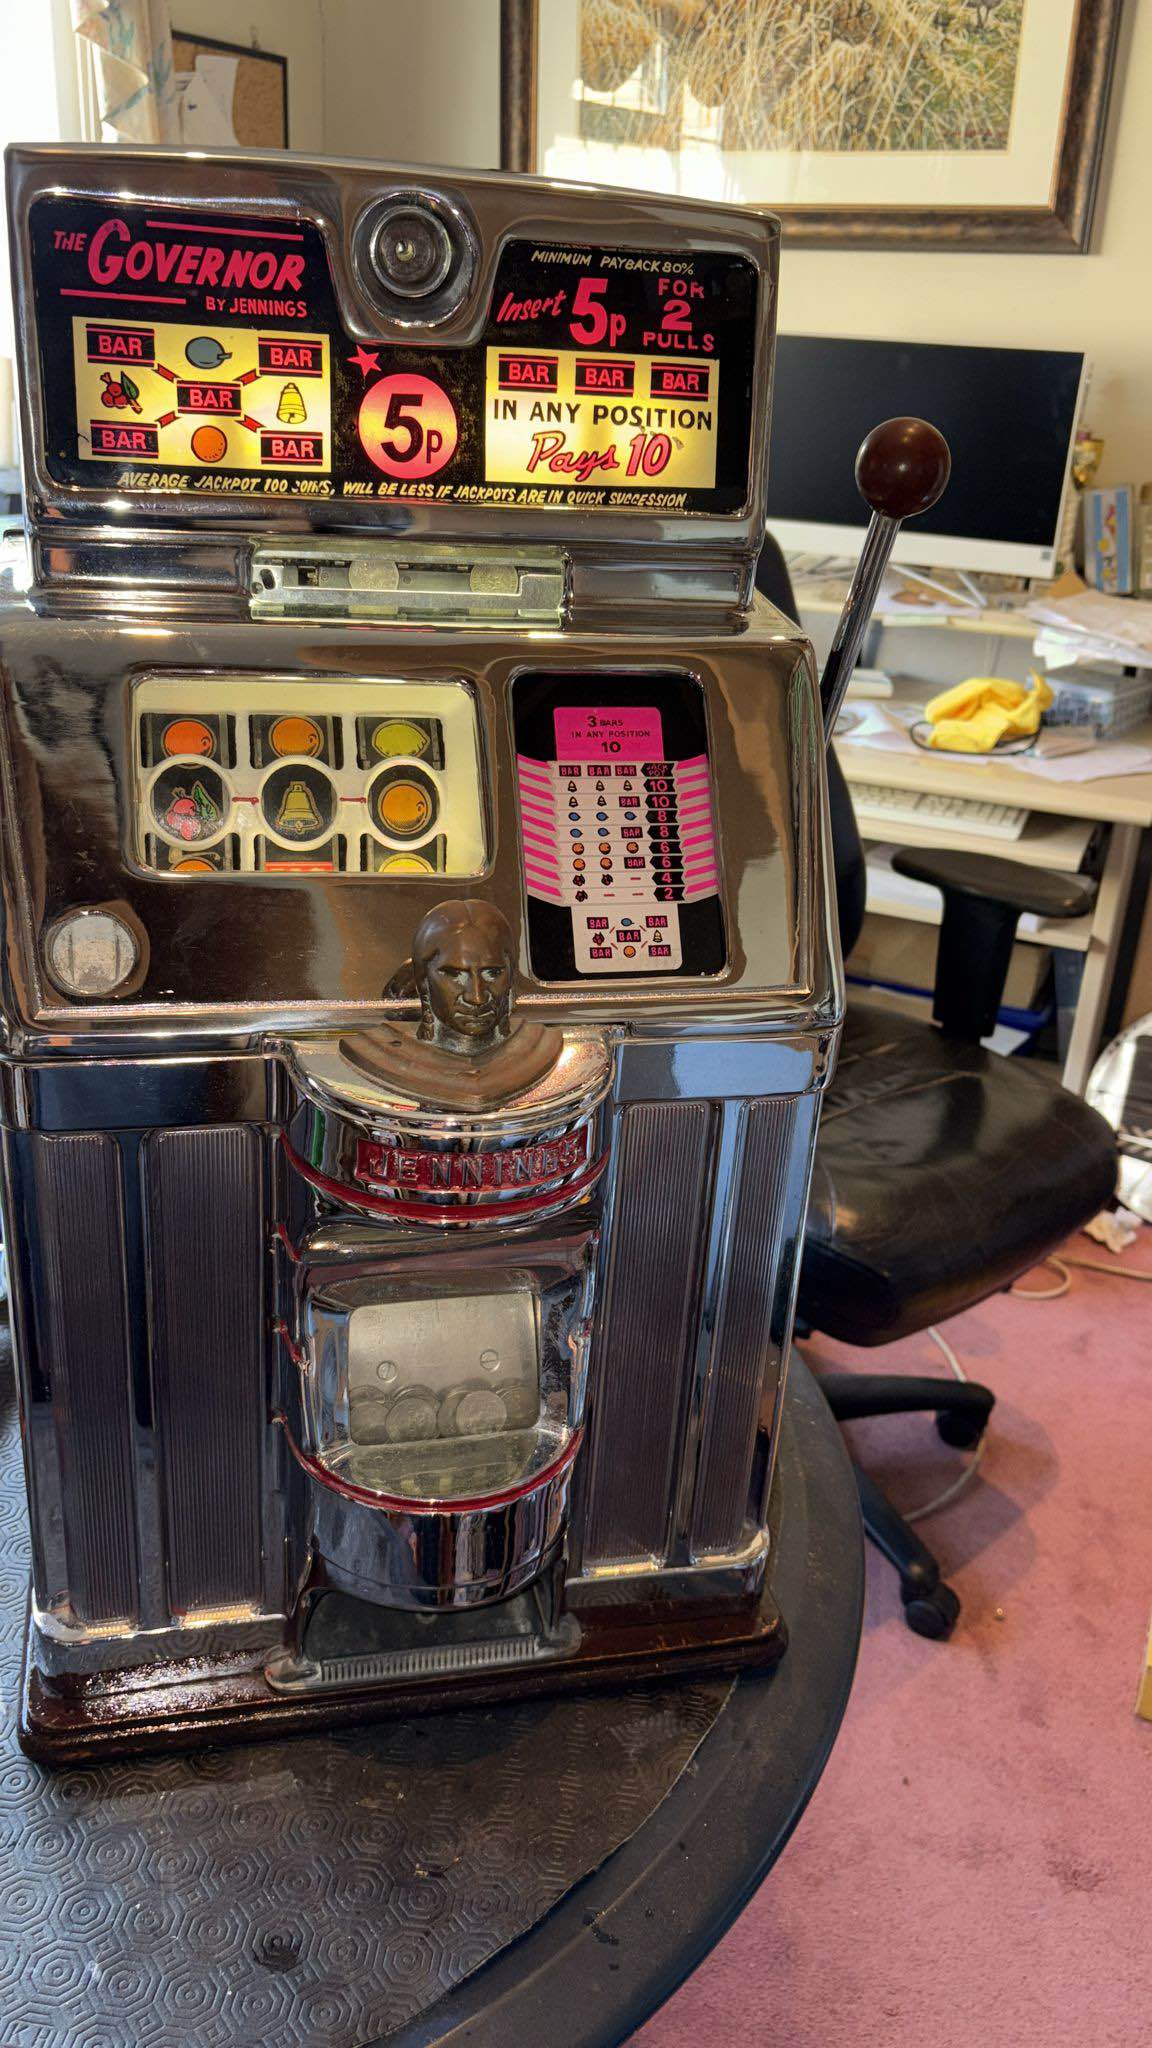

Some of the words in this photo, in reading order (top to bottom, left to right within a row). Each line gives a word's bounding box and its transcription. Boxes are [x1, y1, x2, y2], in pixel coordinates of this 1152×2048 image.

[53, 230, 88, 252] THE
[88, 218, 306, 292] GOVERNOR
[531, 250, 592, 267] MINIMUM
[600, 256, 661, 273] PAYBACK
[662, 261, 695, 276] 80%
[658, 278, 705, 299] FOR
[206, 295, 226, 311] BY
[229, 297, 308, 317] JENNINGS
[496, 289, 567, 323] Insert
[569, 277, 627, 347] 5p
[661, 299, 693, 331] 2
[98, 335, 142, 356] BAR
[643, 331, 715, 352] PULLS
[270, 348, 313, 368] BAR
[508, 363, 550, 382] BAR
[585, 367, 625, 387] BAR
[662, 372, 699, 391] BAR
[189, 390, 233, 408] BAR
[494, 398, 517, 420] IN
[530, 401, 581, 423] ANY
[593, 404, 712, 431] POSITION
[381, 393, 443, 464] 5p
[102, 430, 146, 449] BAR
[272, 439, 314, 458] BAR
[526, 430, 620, 482] Pays
[626, 433, 672, 477] 10
[117, 472, 190, 489] AVERAGE
[194, 474, 261, 492] JACKPOT
[264, 478, 288, 492] 100
[343, 481, 374, 495] WILL
[377, 482, 398, 496] BE
[399, 483, 434, 497] LESS
[436, 485, 453, 499] IF
[453, 485, 517, 502] JACKPOTS
[517, 488, 548, 503] ARE
[547, 489, 563, 504] IN
[566, 490, 606, 506] QUICK
[608, 492, 687, 508] SUCCESSION
[587, 715, 597, 728] 3
[600, 719, 624, 727] BARS
[608, 730, 650, 738] POSITION
[601, 741, 621, 753] 10
[561, 766, 580, 776] BAR
[588, 766, 611, 776] BAR
[616, 766, 636, 776] BAR
[650, 780, 668, 792] 10
[620, 797, 638, 807] BAR
[652, 797, 670, 808] 10
[658, 811, 667, 821] 8
[623, 828, 641, 838] BAR
[660, 826, 669, 837] 8
[660, 841, 670, 853] 6
[626, 858, 644, 867] BAR
[662, 858, 671, 868] 6
[662, 872, 672, 883] 4
[664, 889, 674, 900] 2
[589, 919, 608, 928] BAR
[647, 917, 667, 926] BAR
[618, 931, 639, 941] BAR
[592, 948, 611, 957] BAR
[650, 946, 669, 956] BAR
